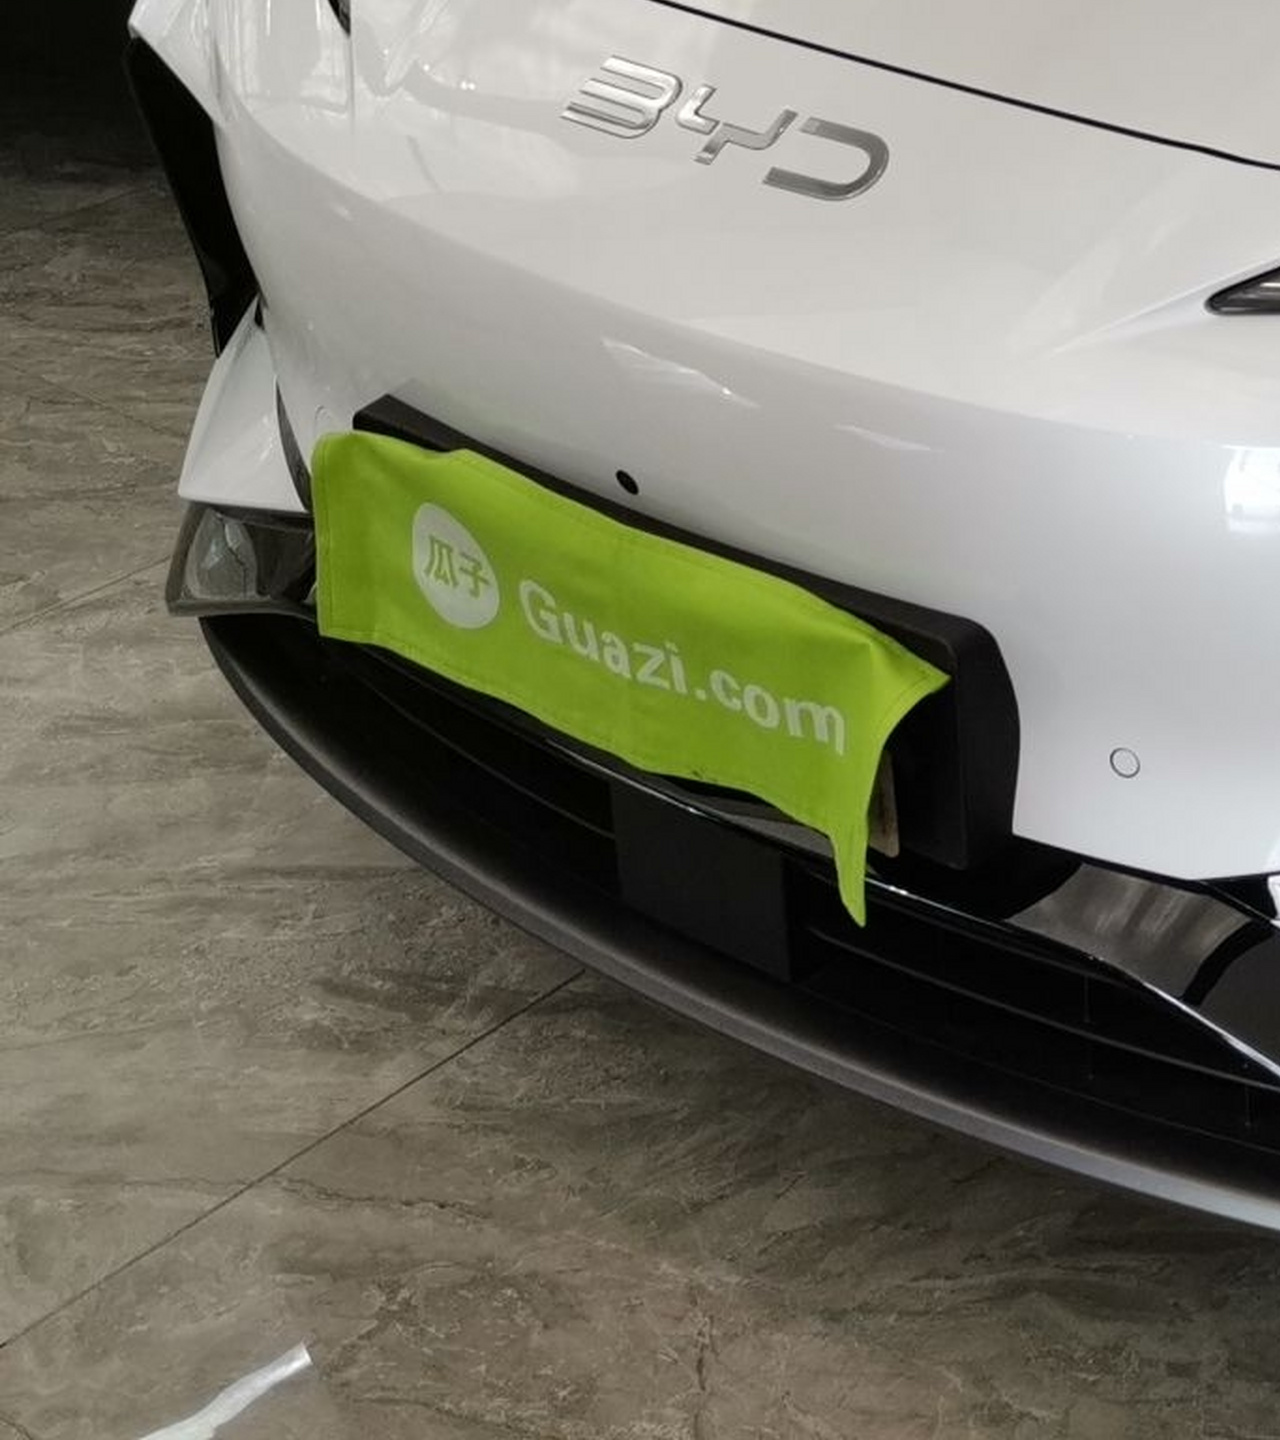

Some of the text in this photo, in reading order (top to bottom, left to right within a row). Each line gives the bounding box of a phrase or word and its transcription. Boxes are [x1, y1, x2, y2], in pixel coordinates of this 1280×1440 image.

[560, 54, 890, 201] BYD
[423, 534, 491, 598] 瓜子
[519, 578, 849, 756] Guazi.com
